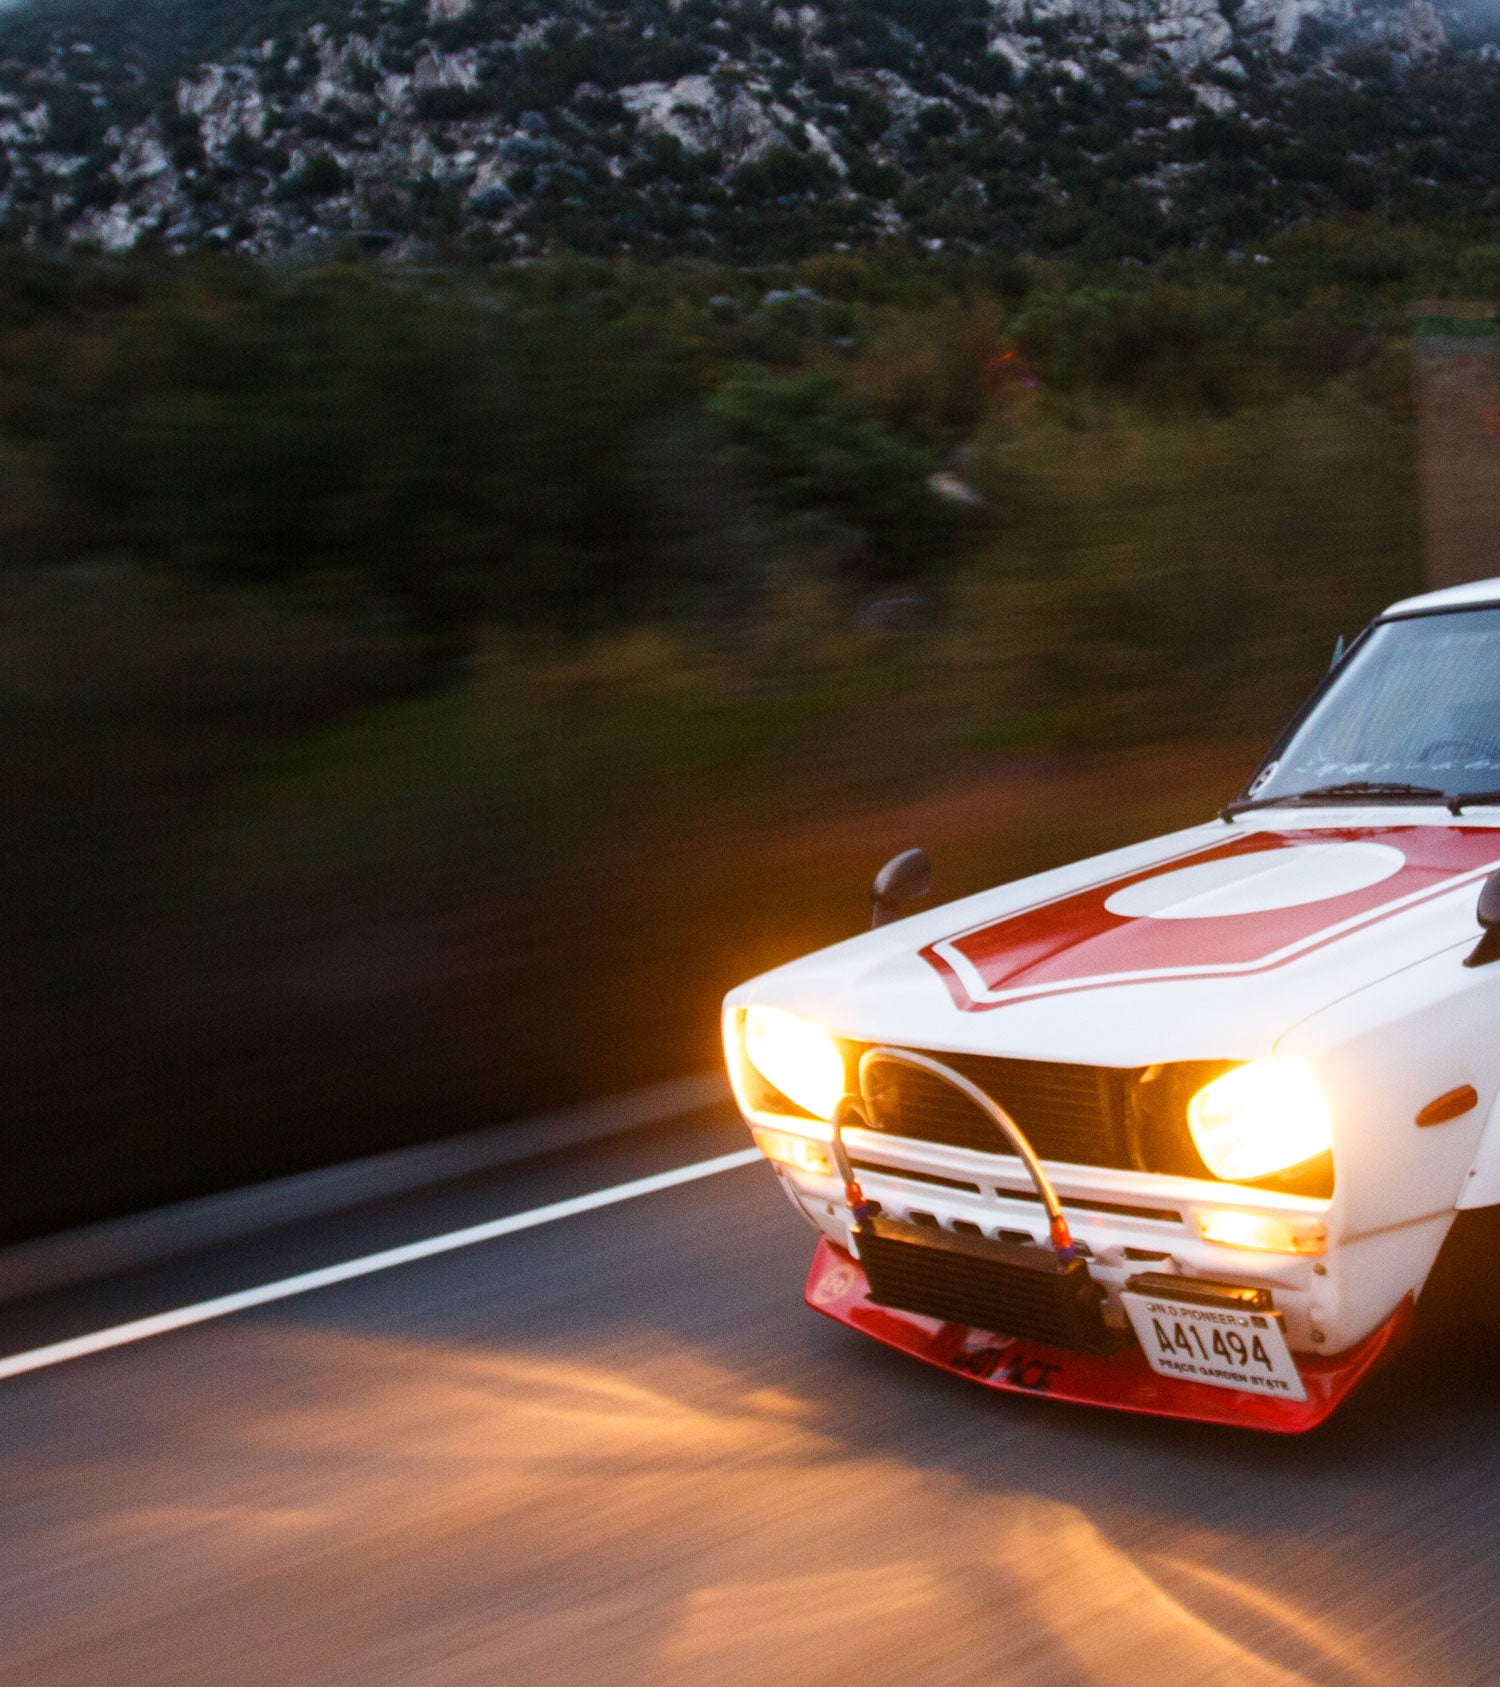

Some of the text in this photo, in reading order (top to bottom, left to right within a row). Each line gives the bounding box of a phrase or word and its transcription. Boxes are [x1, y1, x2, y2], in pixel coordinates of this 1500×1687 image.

[1152, 1318, 1273, 1372] A41494
[1158, 1358, 1289, 1391] PEACE GARDEN STATE
